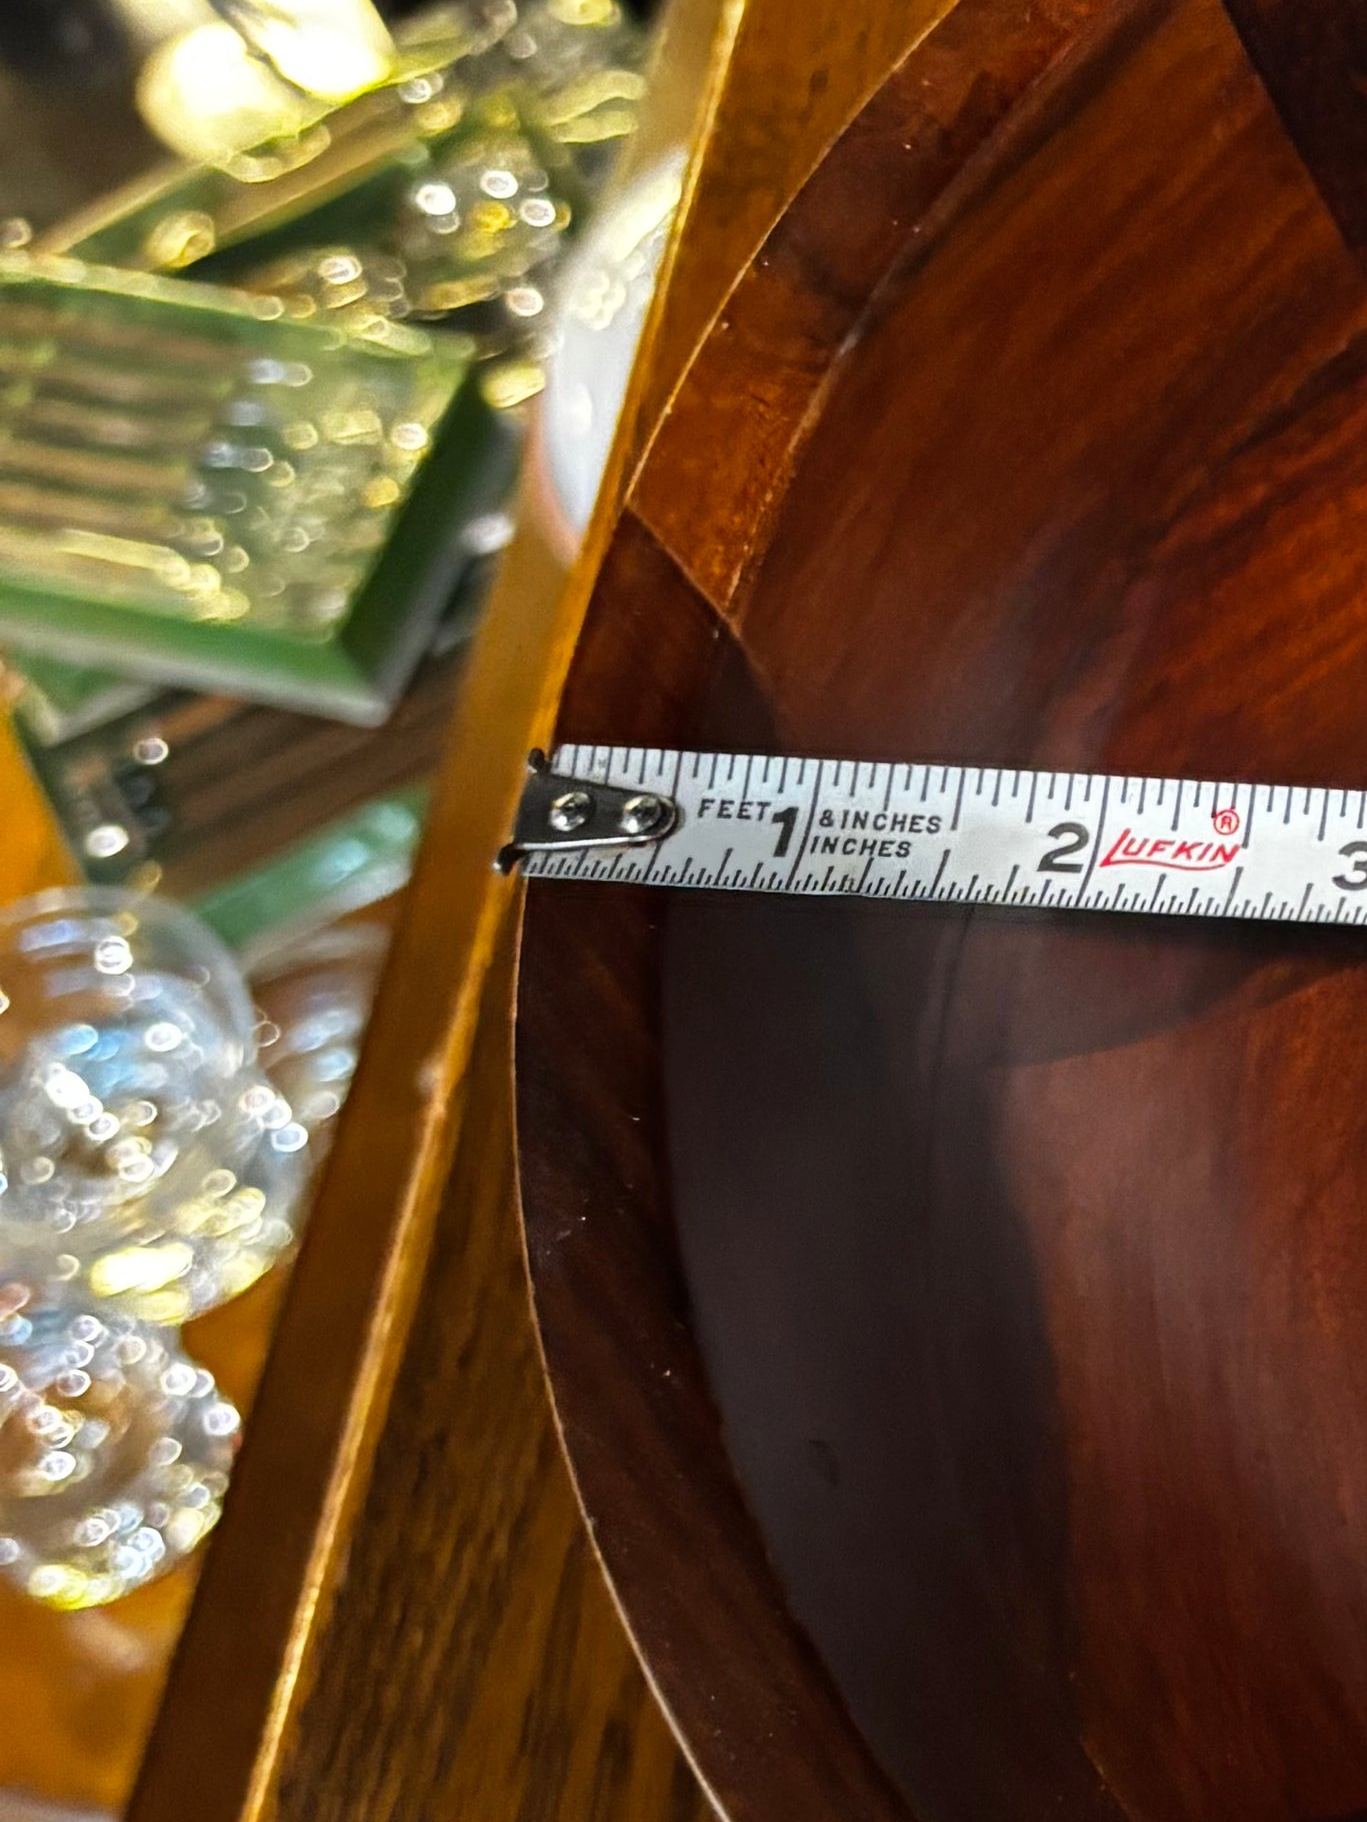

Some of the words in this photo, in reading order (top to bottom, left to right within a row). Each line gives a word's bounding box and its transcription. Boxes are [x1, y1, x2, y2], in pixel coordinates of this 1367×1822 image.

[697, 799, 772, 821] FEET
[771, 806, 799, 857] 1
[810, 836, 912, 858] INCHES
[1037, 822, 1090, 873] 2
[1100, 828, 1240, 870] LUFKIN
